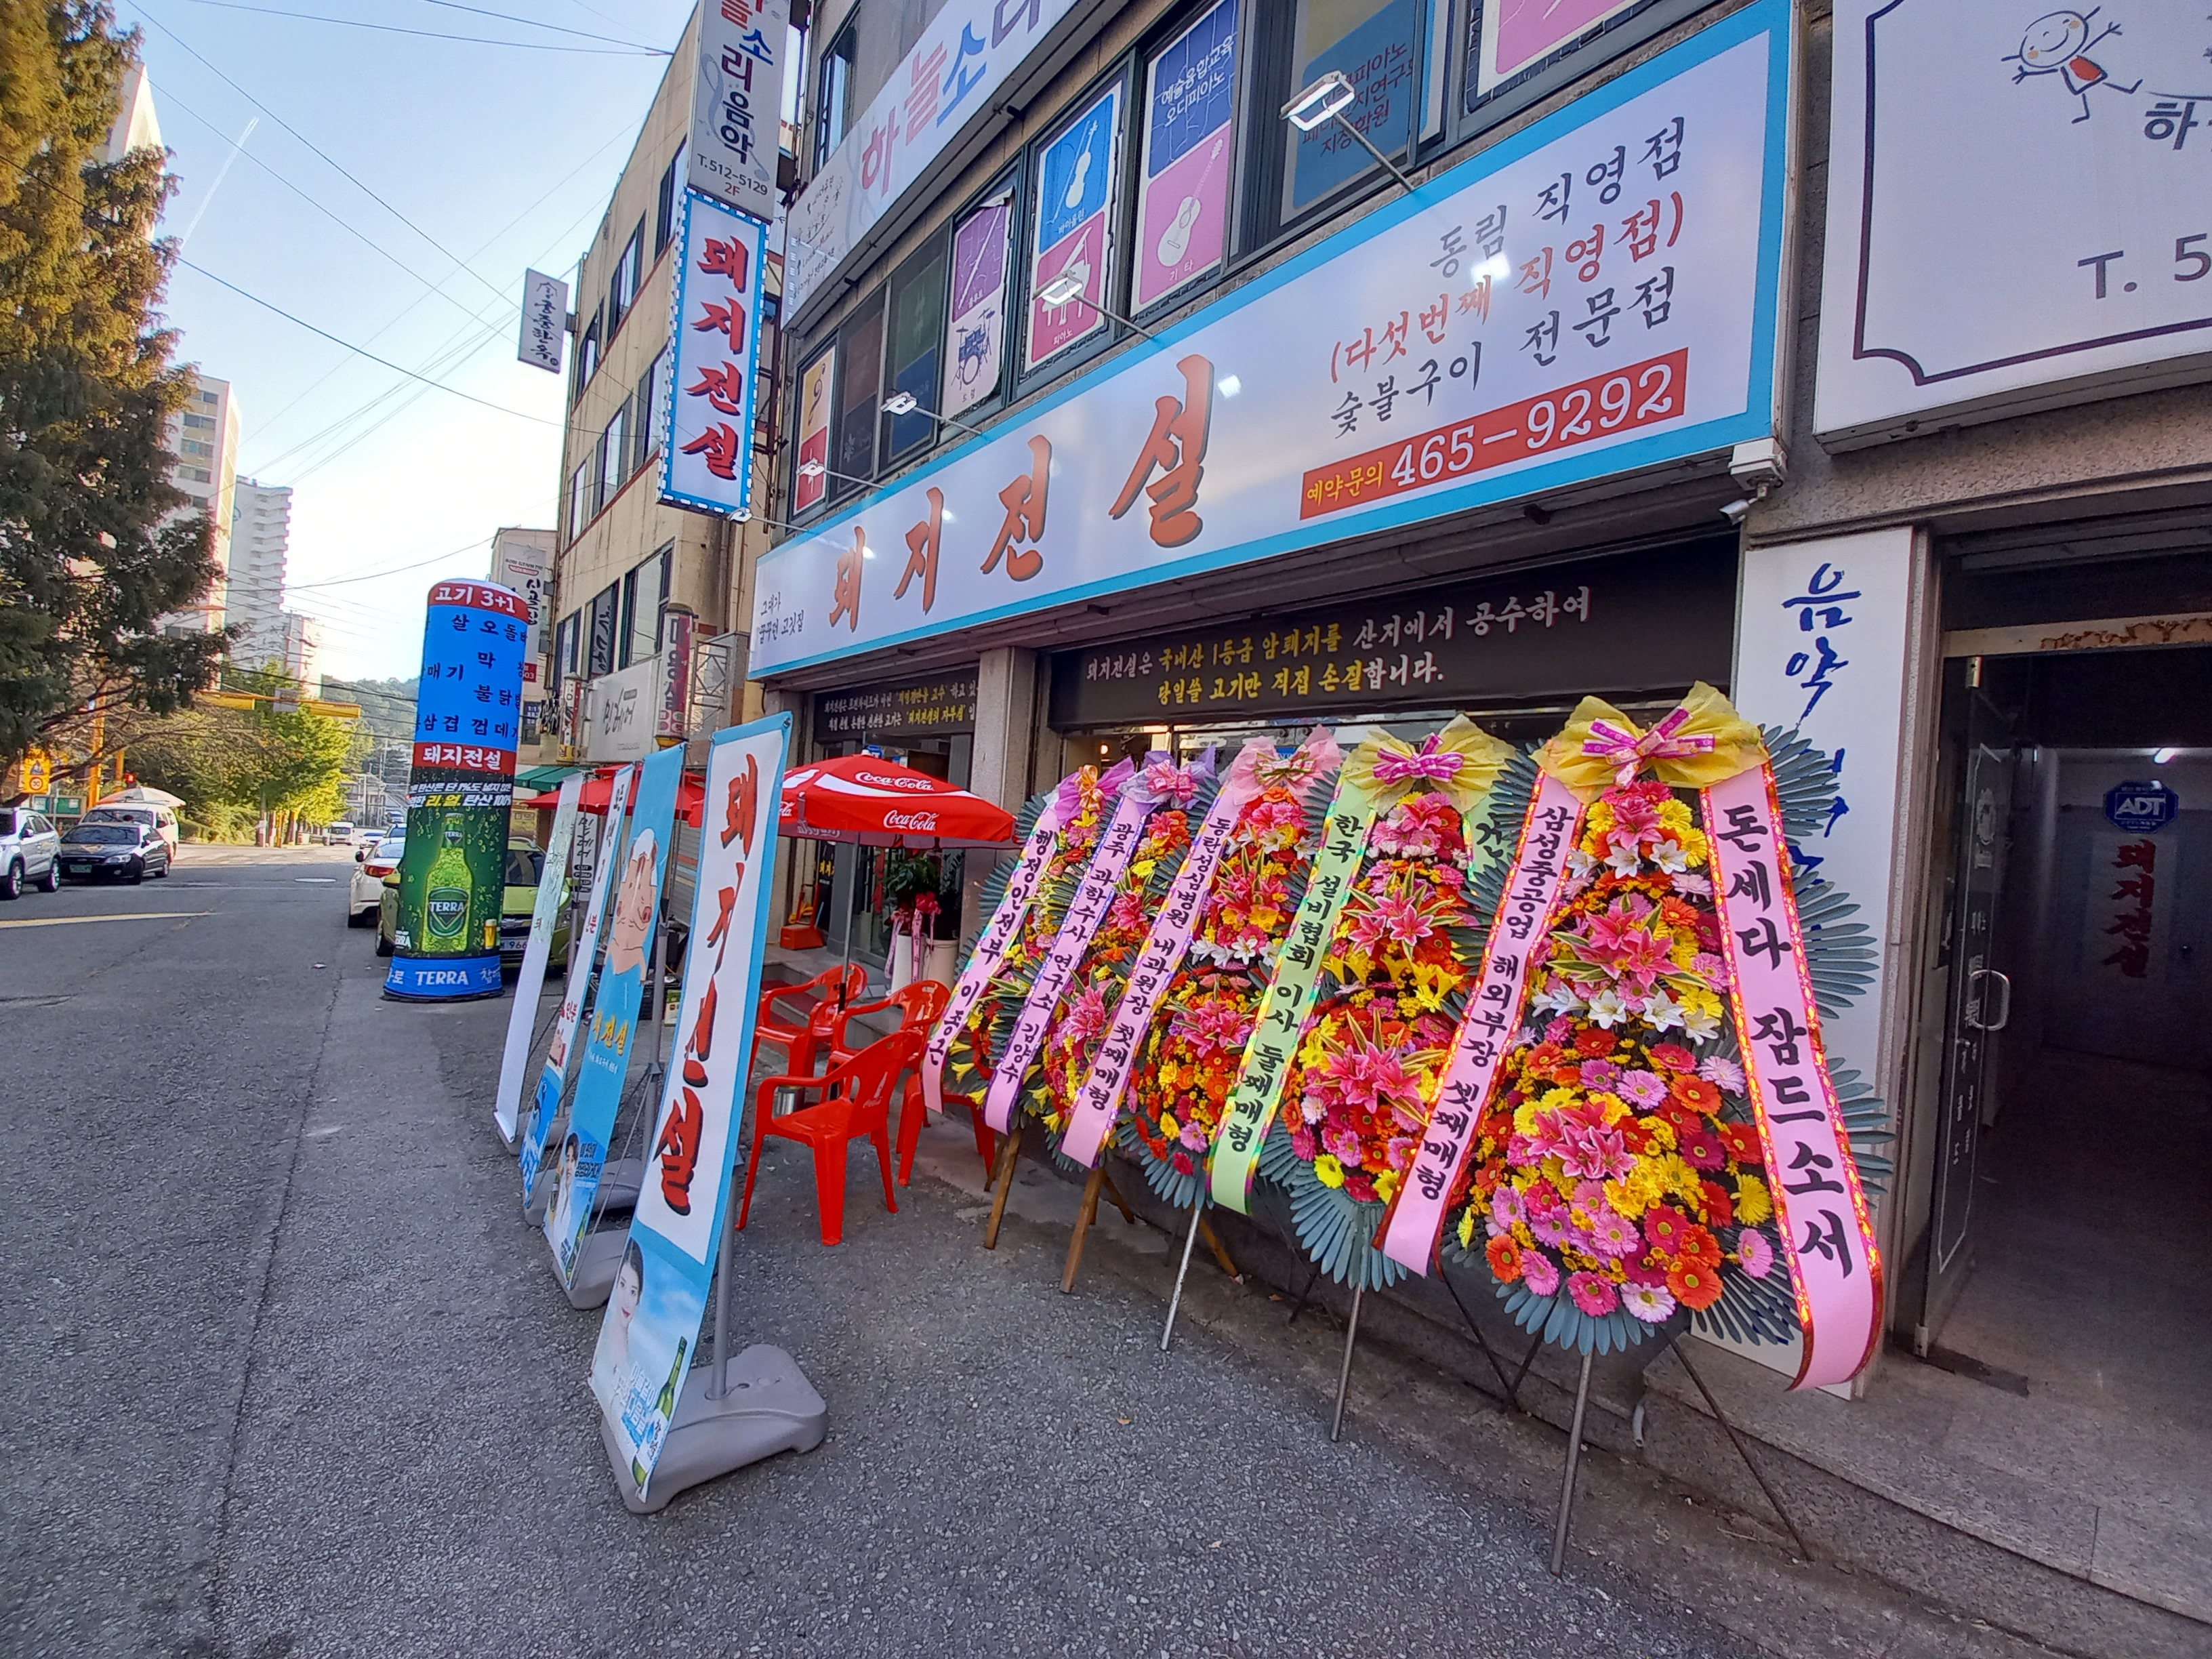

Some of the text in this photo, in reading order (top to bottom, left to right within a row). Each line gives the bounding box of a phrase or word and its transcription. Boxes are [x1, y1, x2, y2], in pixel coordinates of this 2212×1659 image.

[1164, 70, 1225, 127] 오디피아노
[697, 153, 768, 196] T.512-5129
[724, 182, 740, 197] 2F
[1428, 117, 1686, 279] 동림 직영점
[1058, 207, 1085, 234] 바이올린
[1515, 190, 1683, 298] 직영점)
[678, 235, 750, 481] 돼지전설
[1053, 329, 1073, 345] 피아노
[1330, 266, 1677, 441] 숯불구이 전문점
[1307, 363, 1673, 506] 예약문의 465-9292
[830, 354, 1215, 632] 돼지전설
[435, 586, 473, 605] 고기
[480, 591, 515, 613] 3+1
[1086, 651, 1153, 681] 돼지전설은
[1159, 642, 1204, 673] 국내산
[1353, 606, 1454, 649] 산지에서
[1465, 586, 1591, 636] 공수하여
[422, 662, 464, 682] 매기
[1209, 672, 1263, 701] 고기만
[1271, 665, 1311, 696] 직접
[1317, 651, 1446, 692] 손질합니다.
[417, 713, 459, 733] 삼겹
[423, 744, 501, 771] 돼지전설
[855, 771, 935, 792] Coca-Cola
[884, 810, 940, 831] Coca-Cola
[2116, 797, 2166, 816] ADT
[445, 831, 463, 840] TERRA
[430, 901, 465, 912] TERRA
[929, 828, 1056, 1066] 행정안전부 이종근
[1000, 822, 1135, 1084] 광주 과학수사 연구소 김양수
[1088, 817, 1232, 1111] 동탄성심병원 내과원장 첫째매형
[415, 970, 469, 986] TERRA
[653, 753, 758, 1216] 돼지전설
[1228, 814, 1364, 1153] 한국 설비협회 이사 둘째매형
[1416, 806, 1575, 1202] 삼성중공업 해외부장 셋째매형
[1715, 804, 1853, 1279] 돈세다 잠드소서
